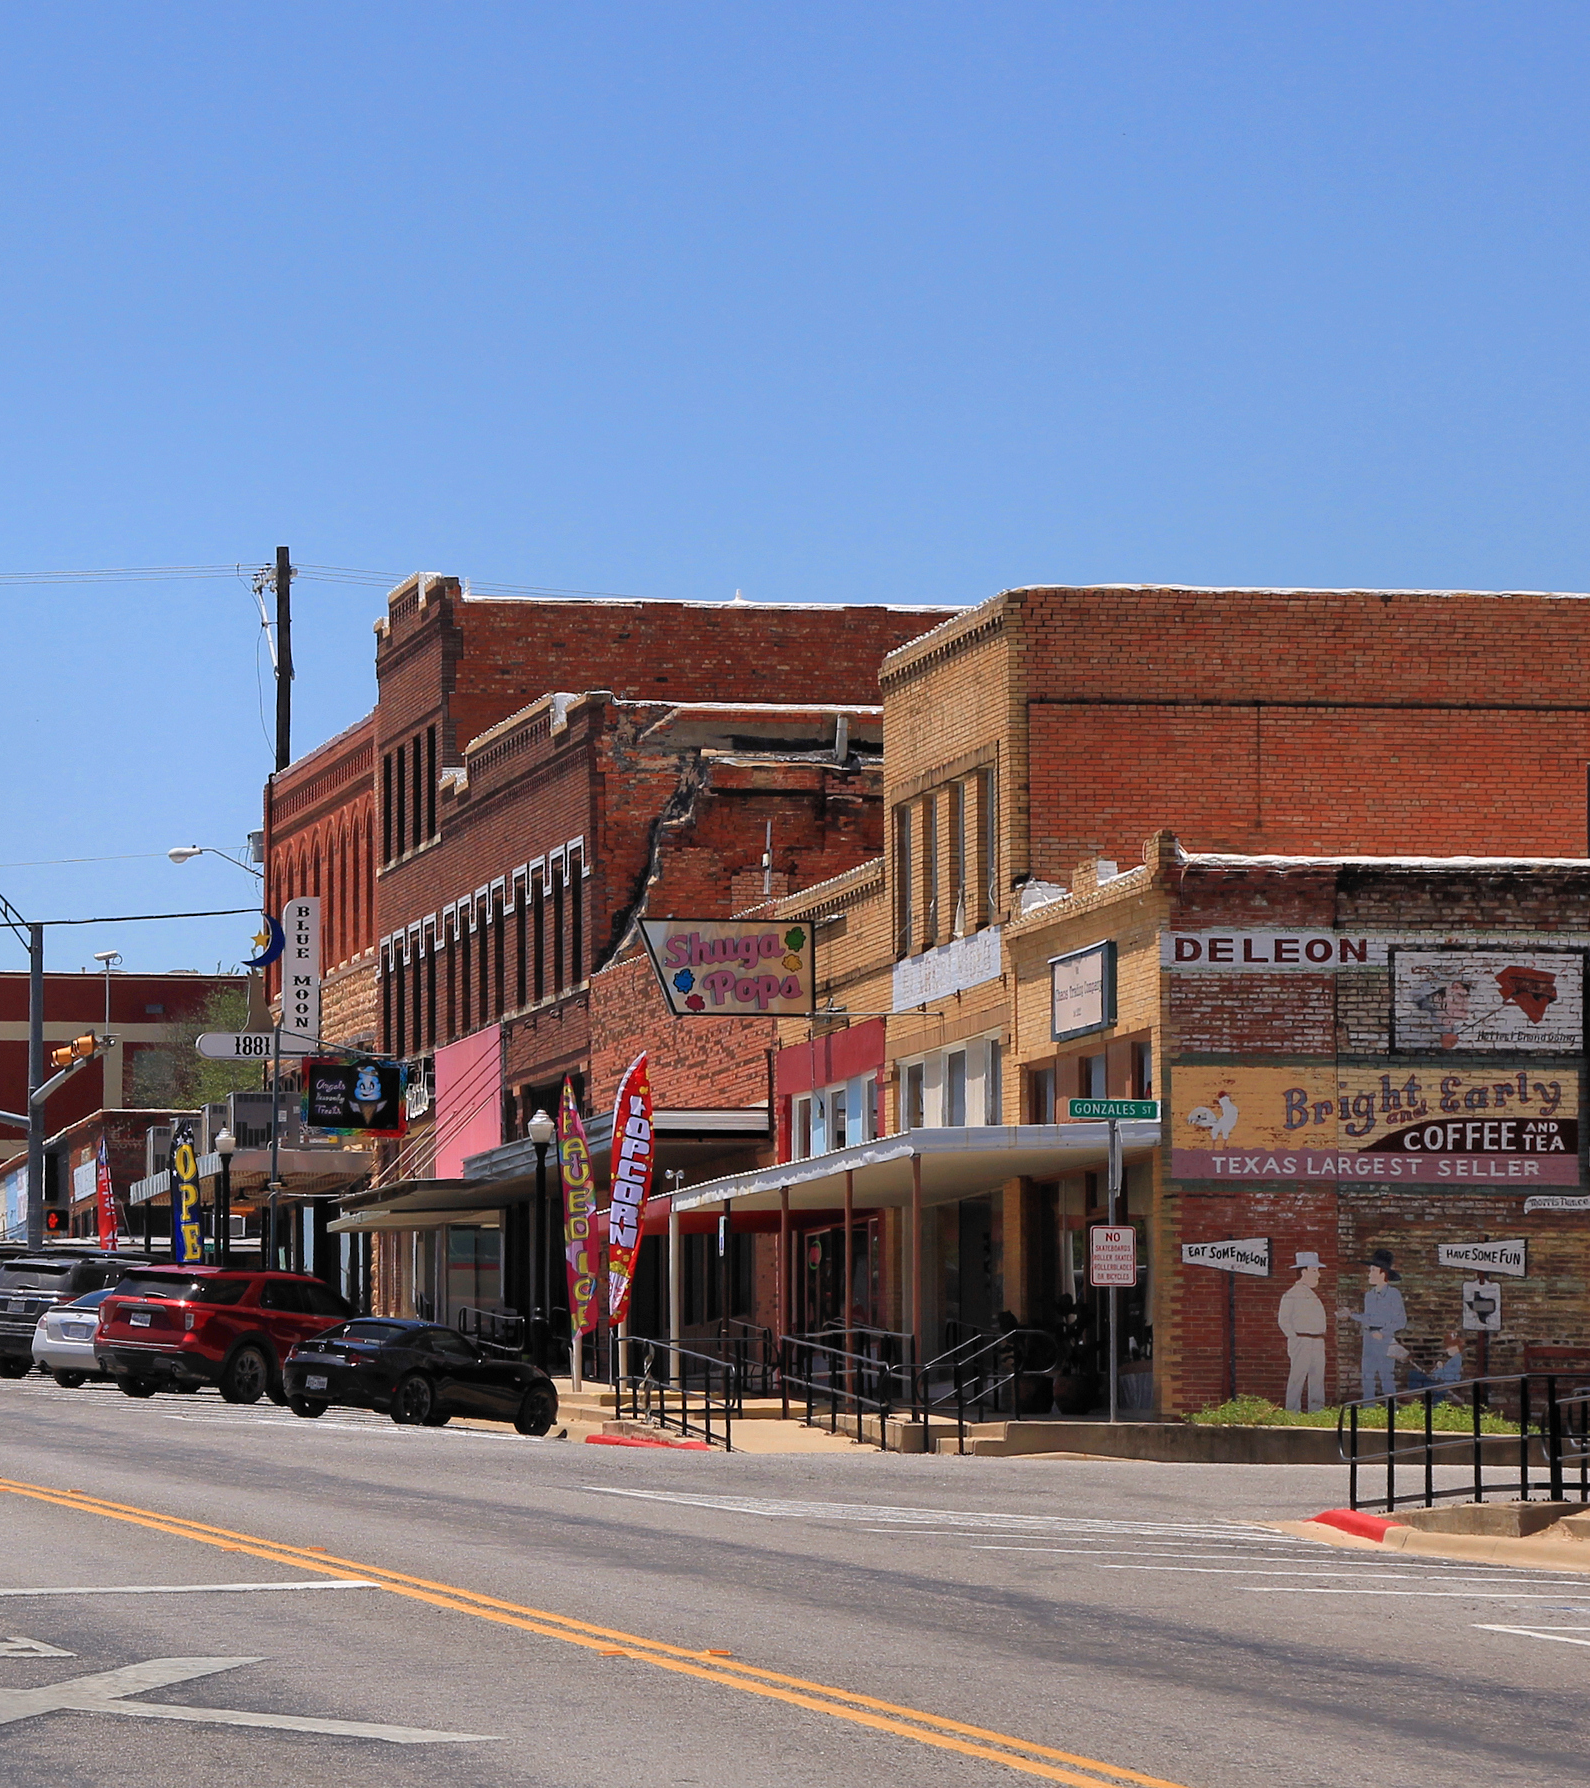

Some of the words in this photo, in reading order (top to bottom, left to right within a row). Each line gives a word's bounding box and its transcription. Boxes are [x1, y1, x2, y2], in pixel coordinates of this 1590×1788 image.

[296, 906, 310, 959] BLUE
[664, 932, 787, 969] Shuga
[293, 975, 312, 1028] MOON
[702, 970, 804, 1010] Pops
[234, 1035, 271, 1056] 1881
[1074, 1103, 1136, 1115] GONZALES
[1142, 1106, 1152, 1115] ST
[1282, 1073, 1423, 1137] Bright
[1386, 1100, 1429, 1125] and
[1440, 1072, 1561, 1116] Early
[1403, 1121, 1518, 1151] COFFEE
[1525, 1122, 1559, 1133] AND
[1522, 1134, 1566, 1151] TEA
[1211, 1156, 1298, 1174] TEXAS
[1307, 1157, 1423, 1176] LARGEST
[1437, 1159, 1540, 1177] SELLER
[175, 1143, 202, 1261] OPE
[1105, 1232, 1121, 1242] NO
[1188, 1246, 1207, 1257] EAT
[1209, 1246, 1236, 1260] SOME
[1236, 1251, 1267, 1267] MELON
[1446, 1249, 1472, 1260] HAVE
[1472, 1248, 1498, 1263] SOME
[1499, 1248, 1521, 1265] FUN
